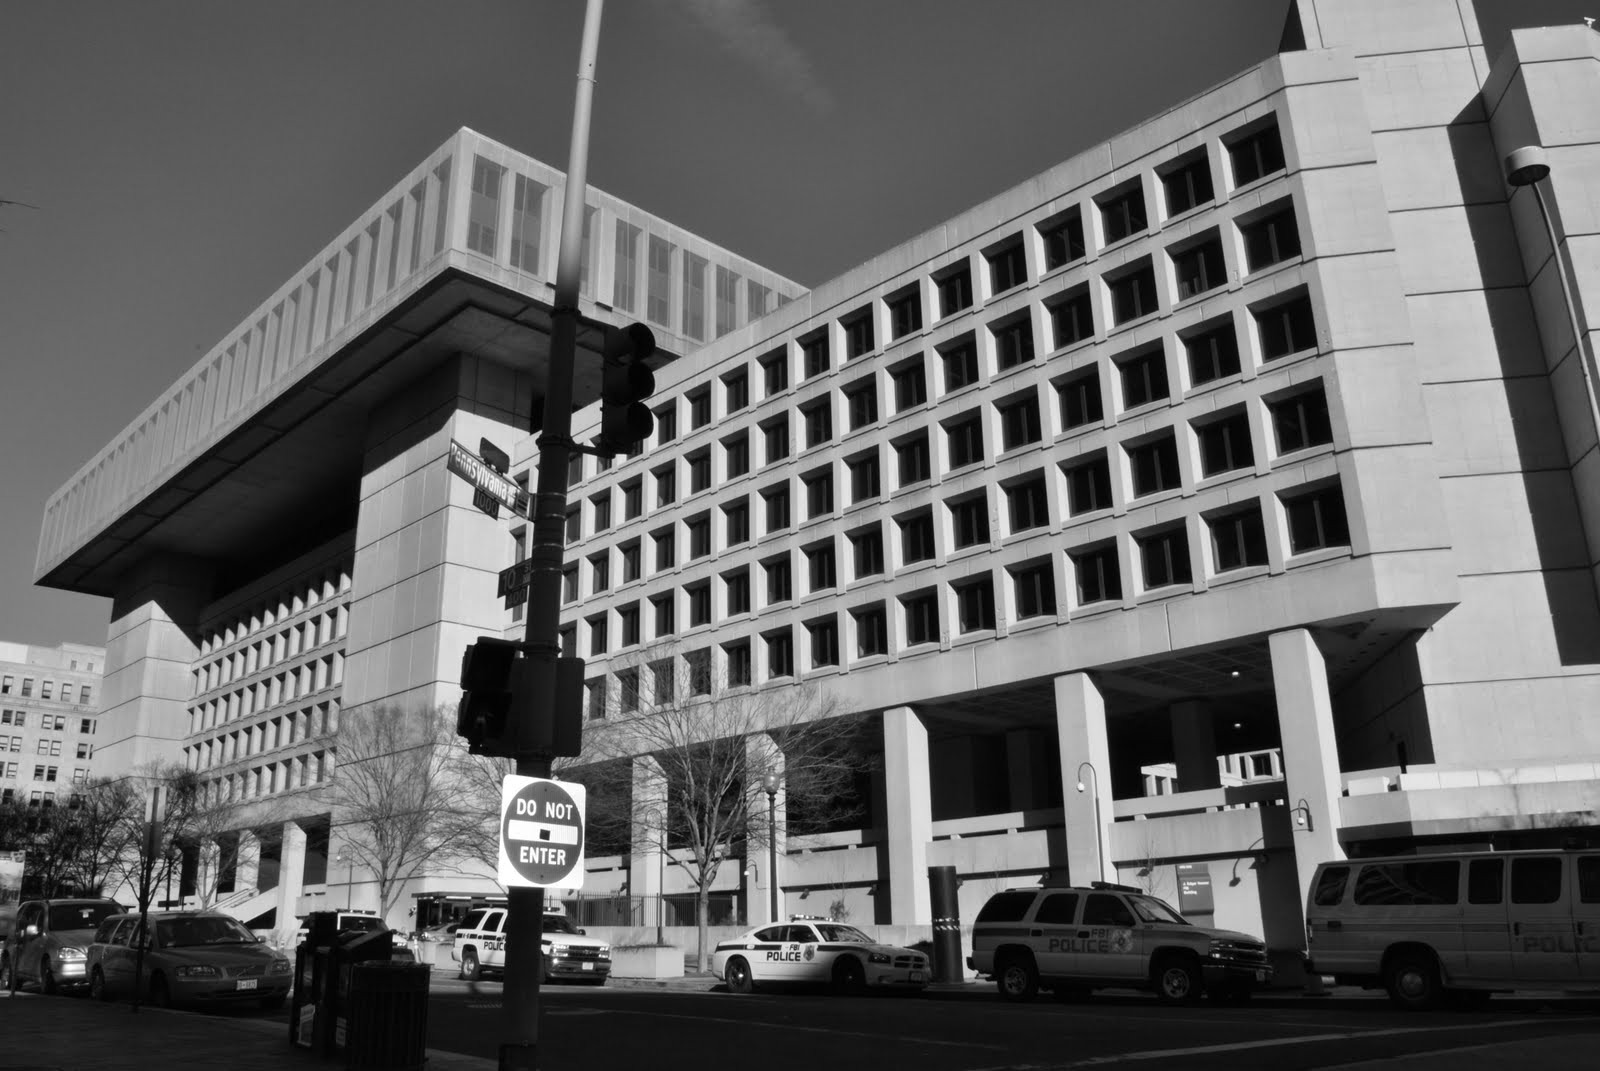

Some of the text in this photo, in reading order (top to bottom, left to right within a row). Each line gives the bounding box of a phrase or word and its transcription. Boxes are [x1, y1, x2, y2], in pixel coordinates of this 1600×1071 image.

[450, 442, 507, 501] Pennsylvania
[475, 490, 498, 515] 1000
[502, 568, 516, 592] 10
[516, 798, 573, 820] DO NOT
[520, 846, 566, 866] ENTER
[1090, 928, 1109, 938] FBI
[484, 941, 506, 951] POLIC
[1048, 938, 1109, 953] POLICE
[1522, 936, 1600, 952] POLIC
[766, 951, 801, 962] POLICE
